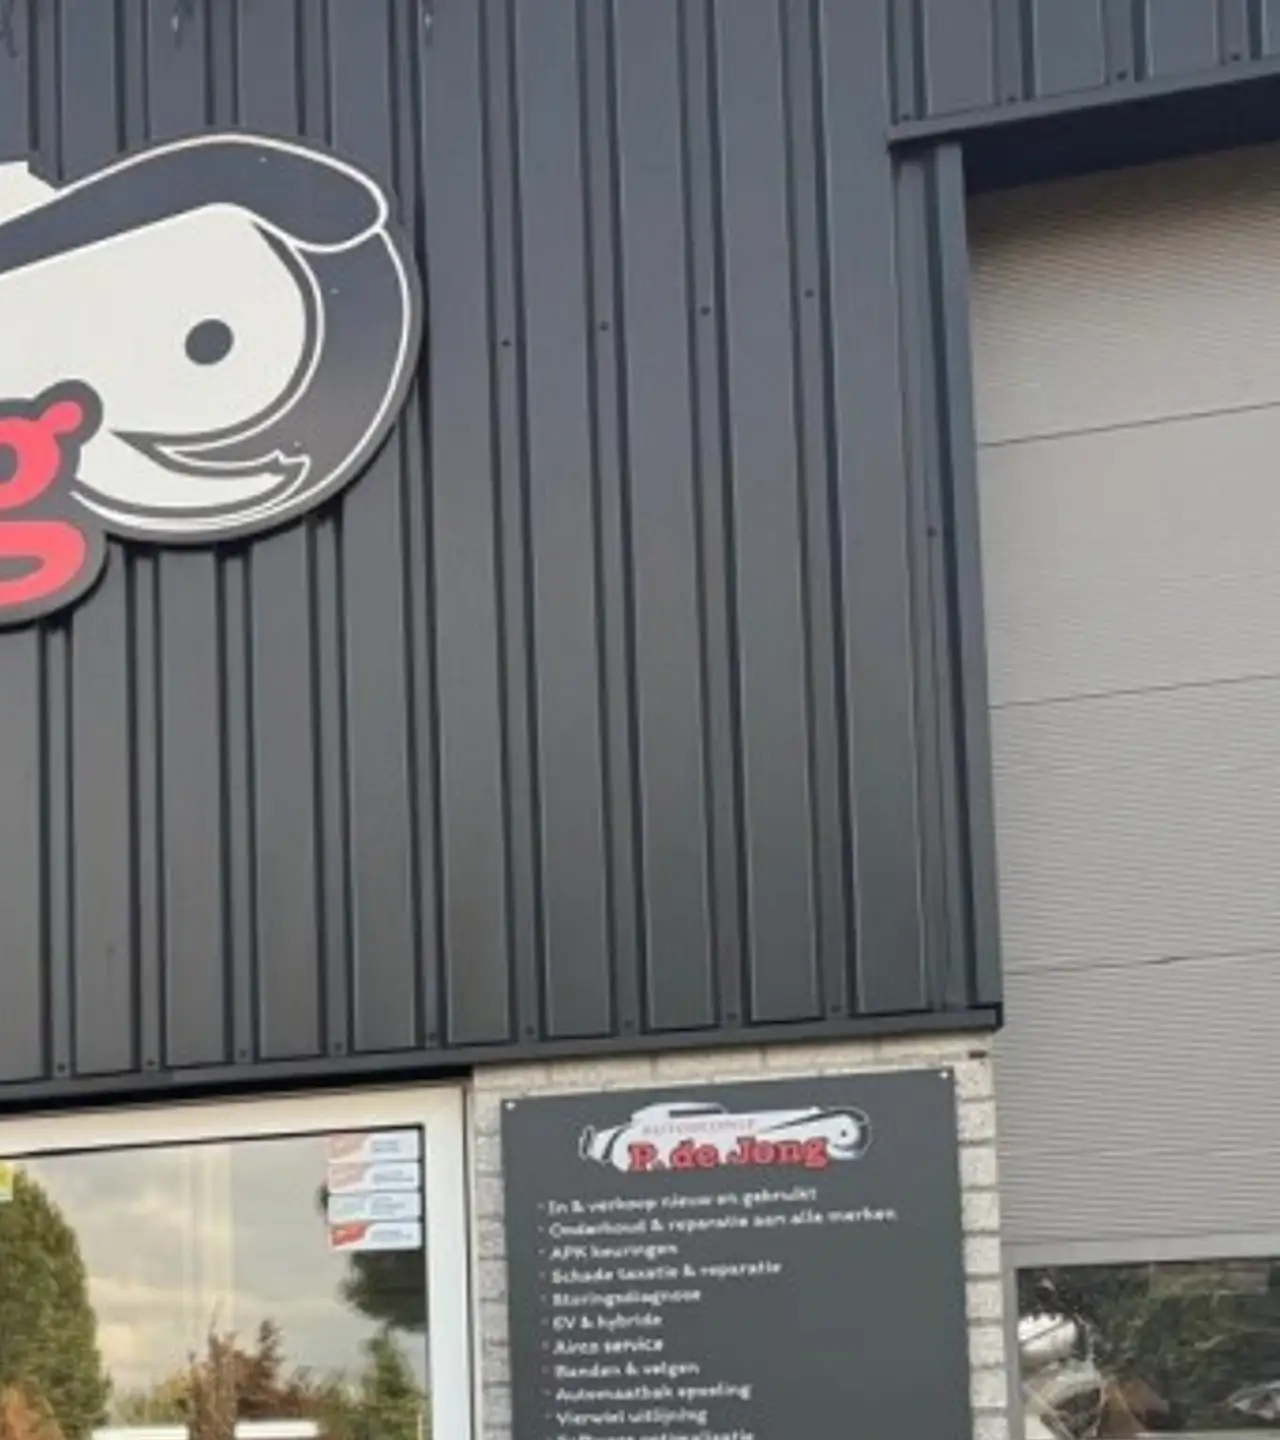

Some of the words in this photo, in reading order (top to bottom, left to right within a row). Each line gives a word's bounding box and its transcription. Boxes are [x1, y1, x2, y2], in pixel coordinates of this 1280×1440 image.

[628, 1141, 666, 1172] P.
[670, 1138, 718, 1170] de
[727, 1135, 828, 1169] Jong
[588, 1196, 657, 1213] verkoop
[661, 1192, 711, 1207] nieuw
[742, 1185, 817, 1208] gebruikt
[549, 1220, 646, 1238] Onderhoud
[669, 1215, 748, 1235] reparatie
[790, 1208, 824, 1225] alle
[828, 1206, 898, 1223] merken
[550, 1245, 587, 1260] APK
[552, 1267, 614, 1284] Schade
[700, 1260, 782, 1281] reparatie
[552, 1316, 576, 1331] EV
[597, 1312, 662, 1332] hybride
[552, 1339, 599, 1355] Airco
[604, 1336, 664, 1353] service
[554, 1362, 622, 1379] Banden
[642, 1361, 700, 1379] velgen
